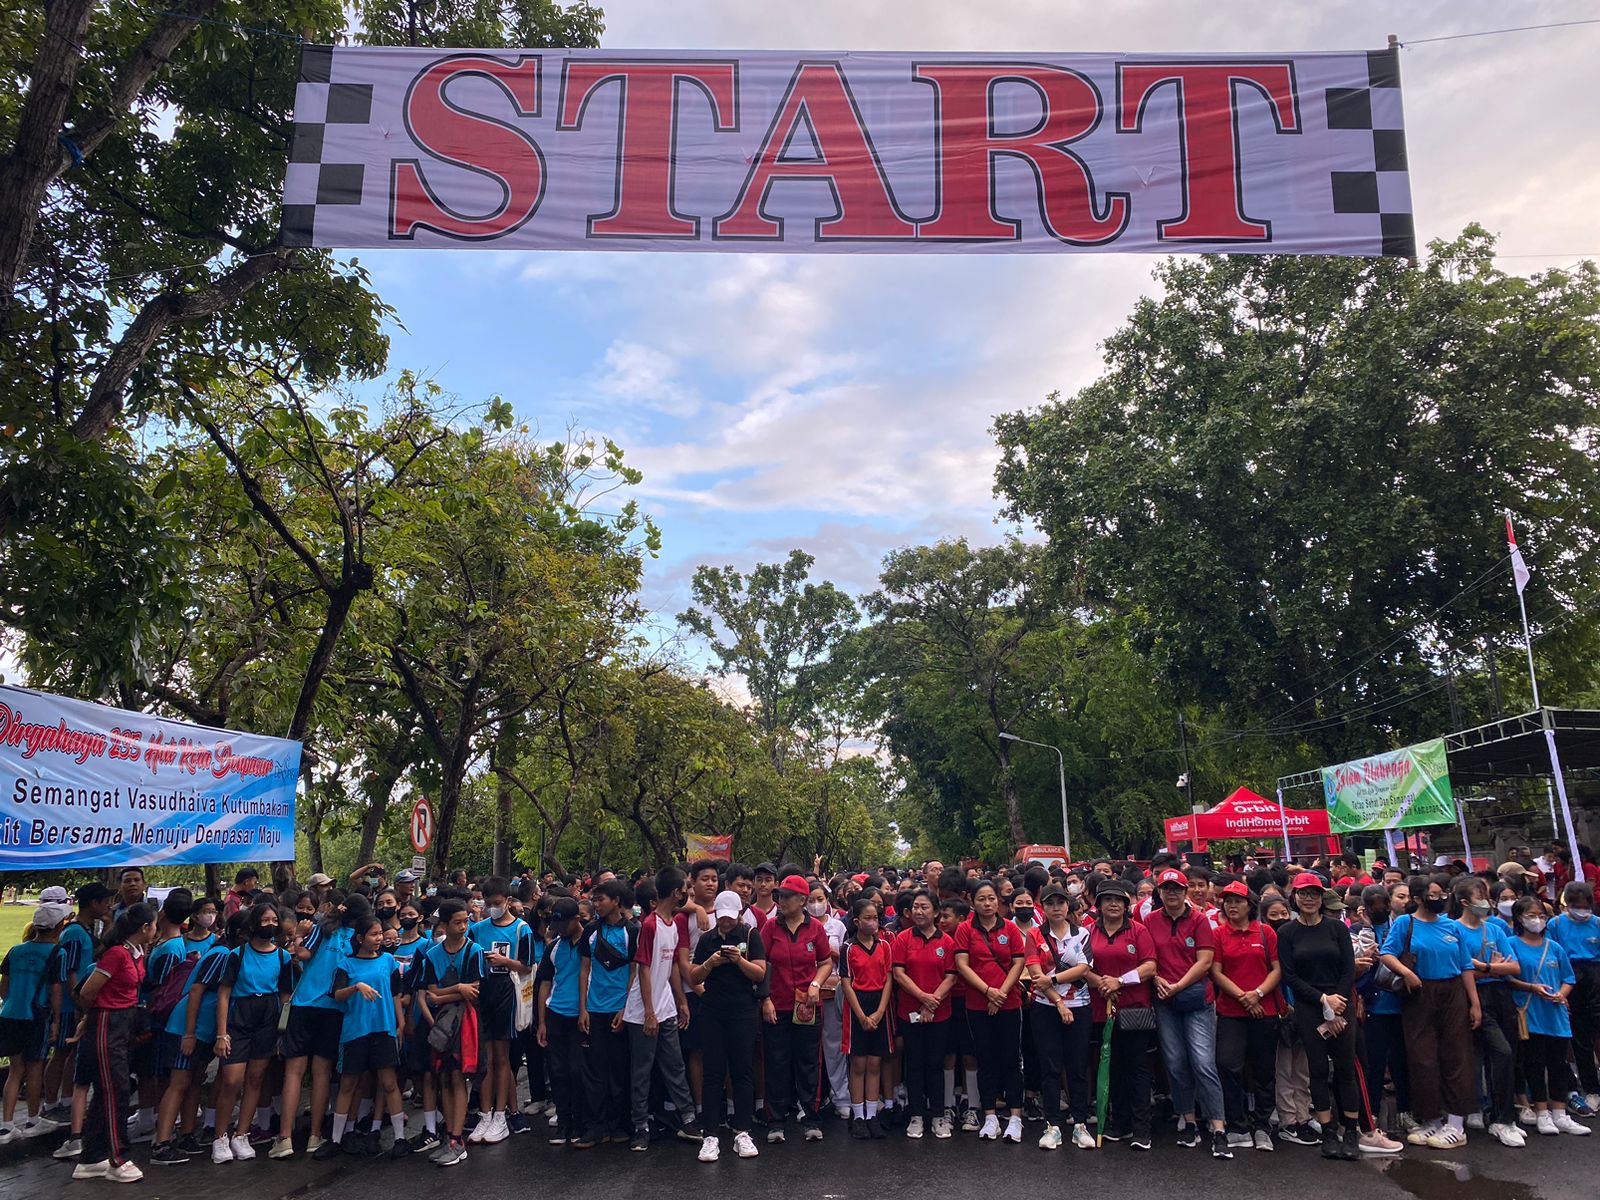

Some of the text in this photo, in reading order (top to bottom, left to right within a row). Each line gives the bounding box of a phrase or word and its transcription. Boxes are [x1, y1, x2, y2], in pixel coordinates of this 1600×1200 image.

[389, 53, 1304, 246] START
[108, 727, 142, 761] 235
[178, 736, 213, 775] Kota
[211, 740, 274, 783] Denpasar
[13, 777, 290, 817] Semangat Vasudhaiva Kutumbakam
[1234, 805, 1278, 813] Orbit
[0, 818, 281, 850] it Bersama Menuju Denpasar Maju
[1226, 816, 1281, 828] IndiHome
